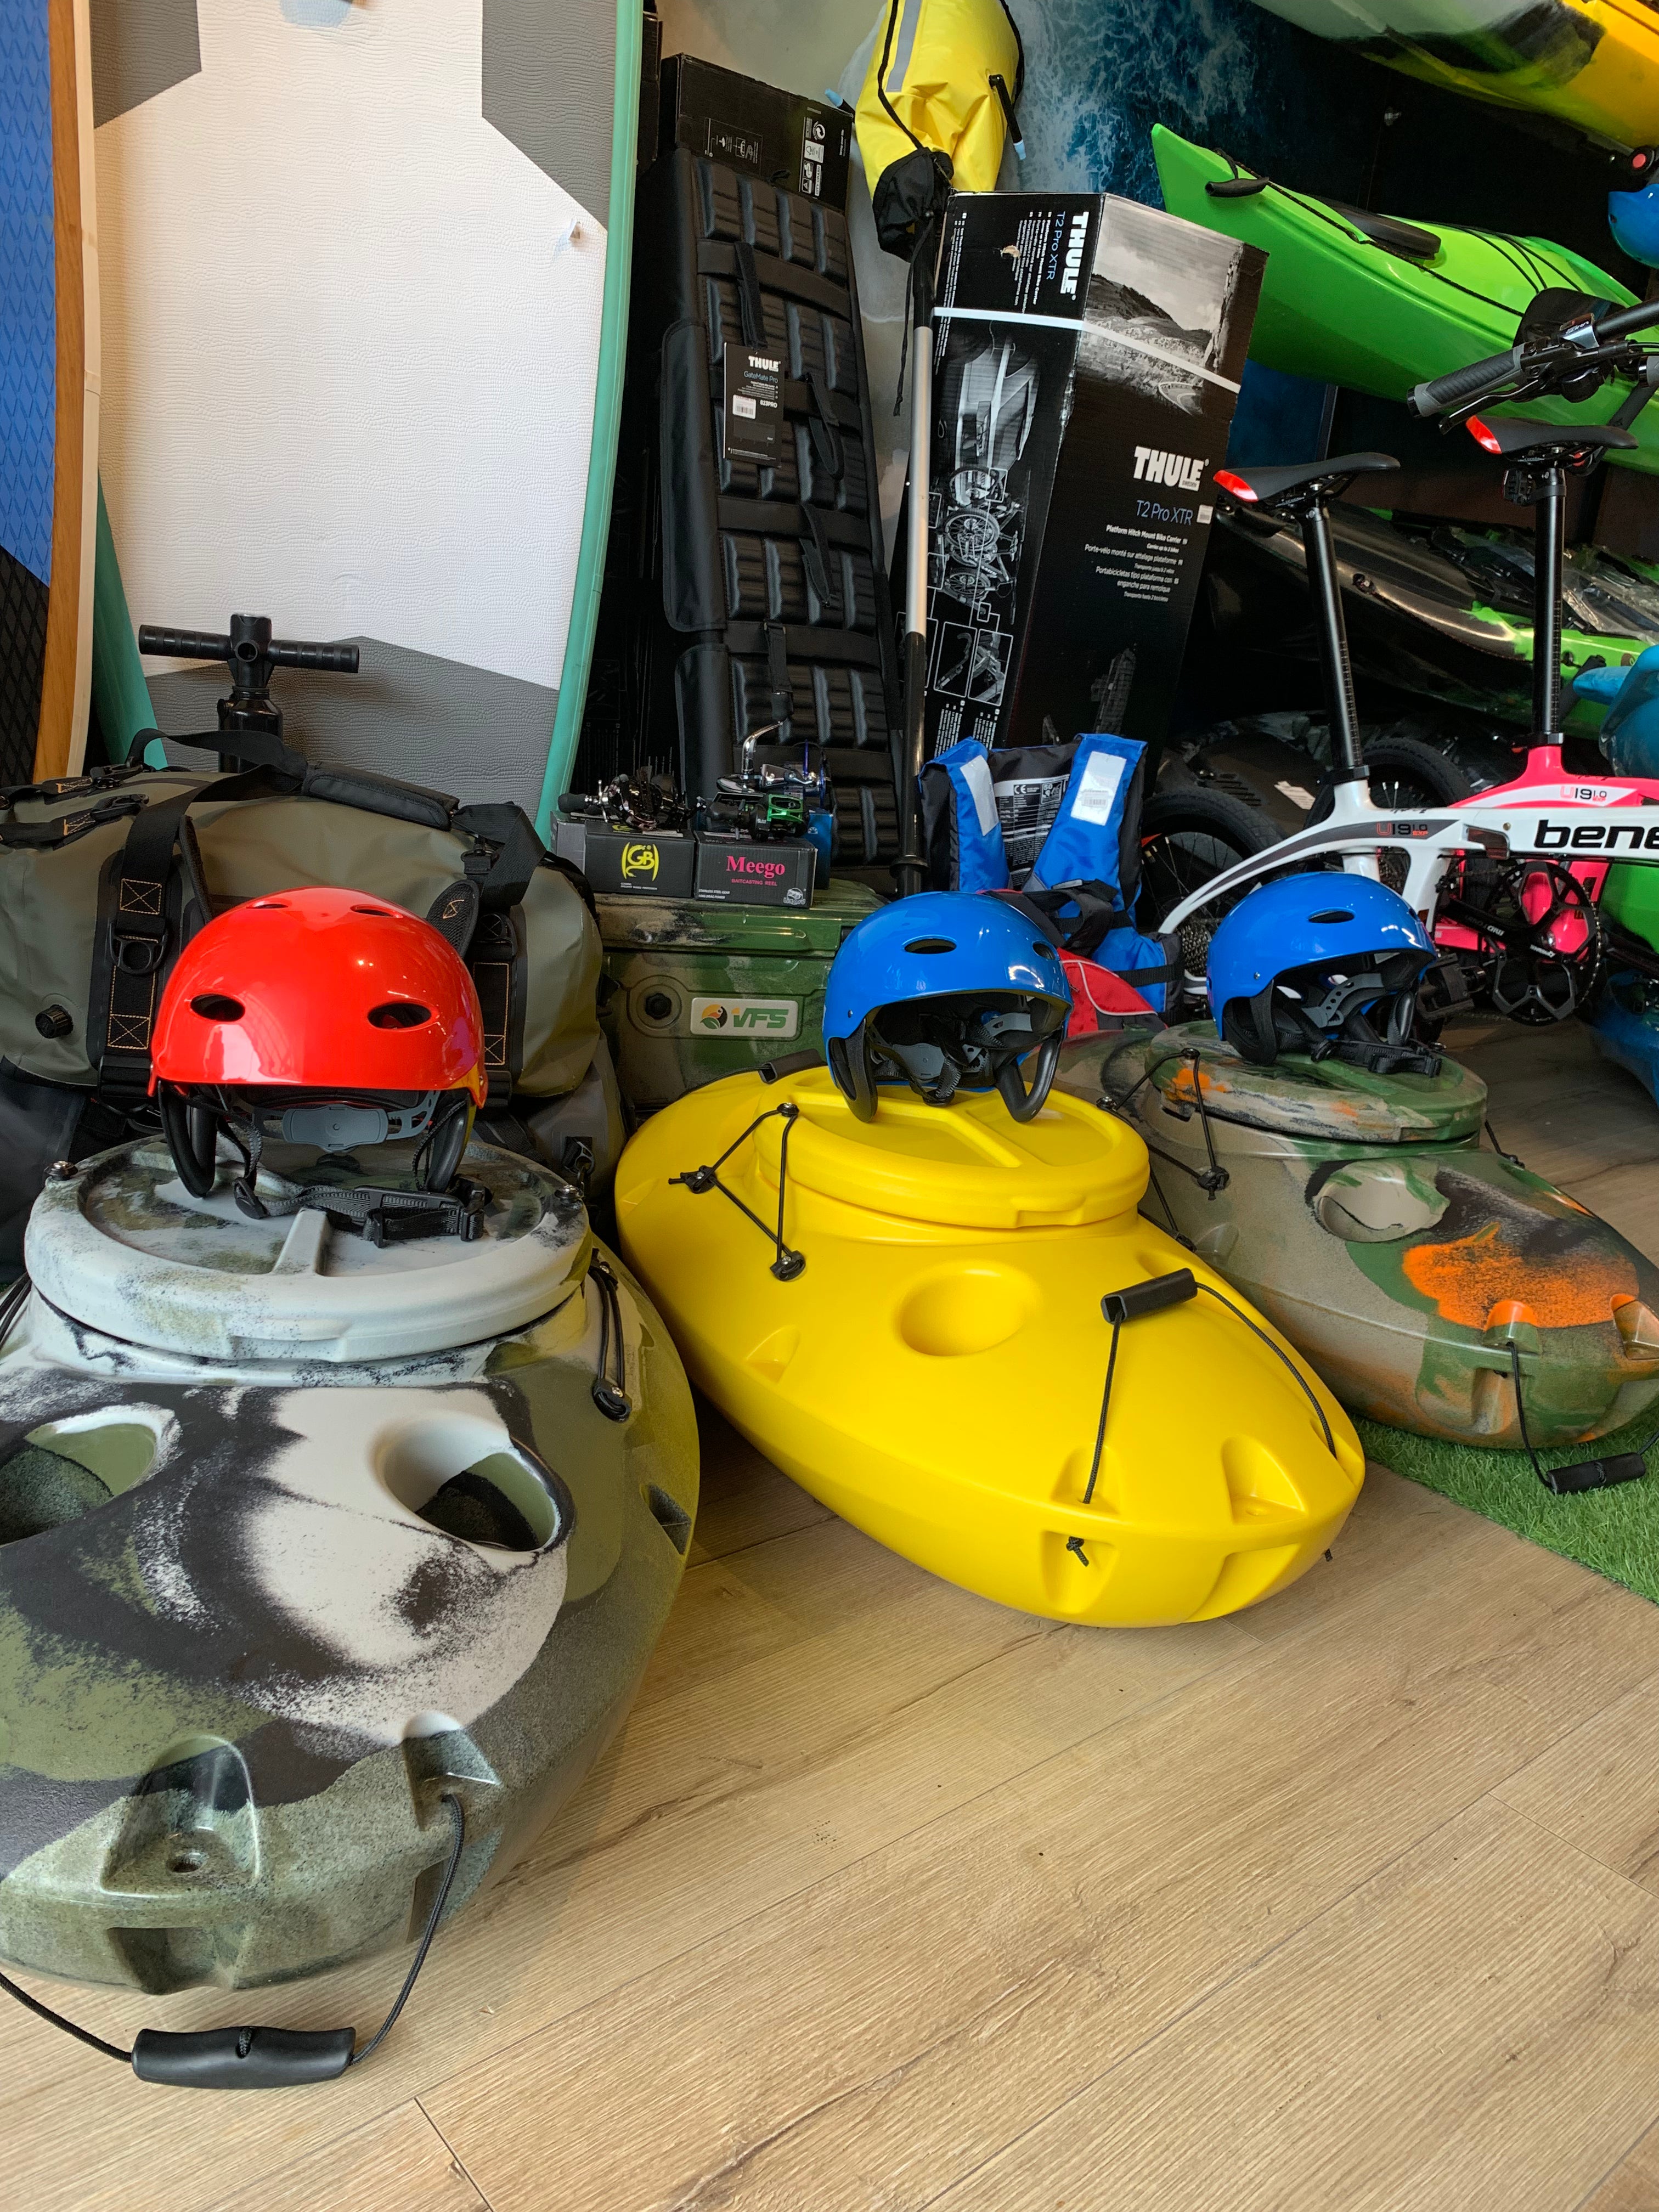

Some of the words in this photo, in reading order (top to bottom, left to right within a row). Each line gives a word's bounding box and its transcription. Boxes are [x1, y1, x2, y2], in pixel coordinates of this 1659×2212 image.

[1056, 211, 1065, 227] T2
[1052, 230, 1062, 251] Pro
[1060, 212, 1089, 294] THULE
[1046, 254, 1058, 279] XTR
[748, 356, 779, 372] THULE
[744, 371, 768, 381] GateMate
[1133, 445, 1204, 492] THULE
[1137, 500, 1151, 518] T2
[1151, 503, 1170, 521] Pro
[1171, 507, 1193, 526] XTR
[1106, 524, 1127, 534] Platform
[1141, 531, 1155, 539] Mount
[1014, 785, 1026, 794] CE
[1376, 822, 1411, 836] U19
[725, 856, 786, 878] Meego
